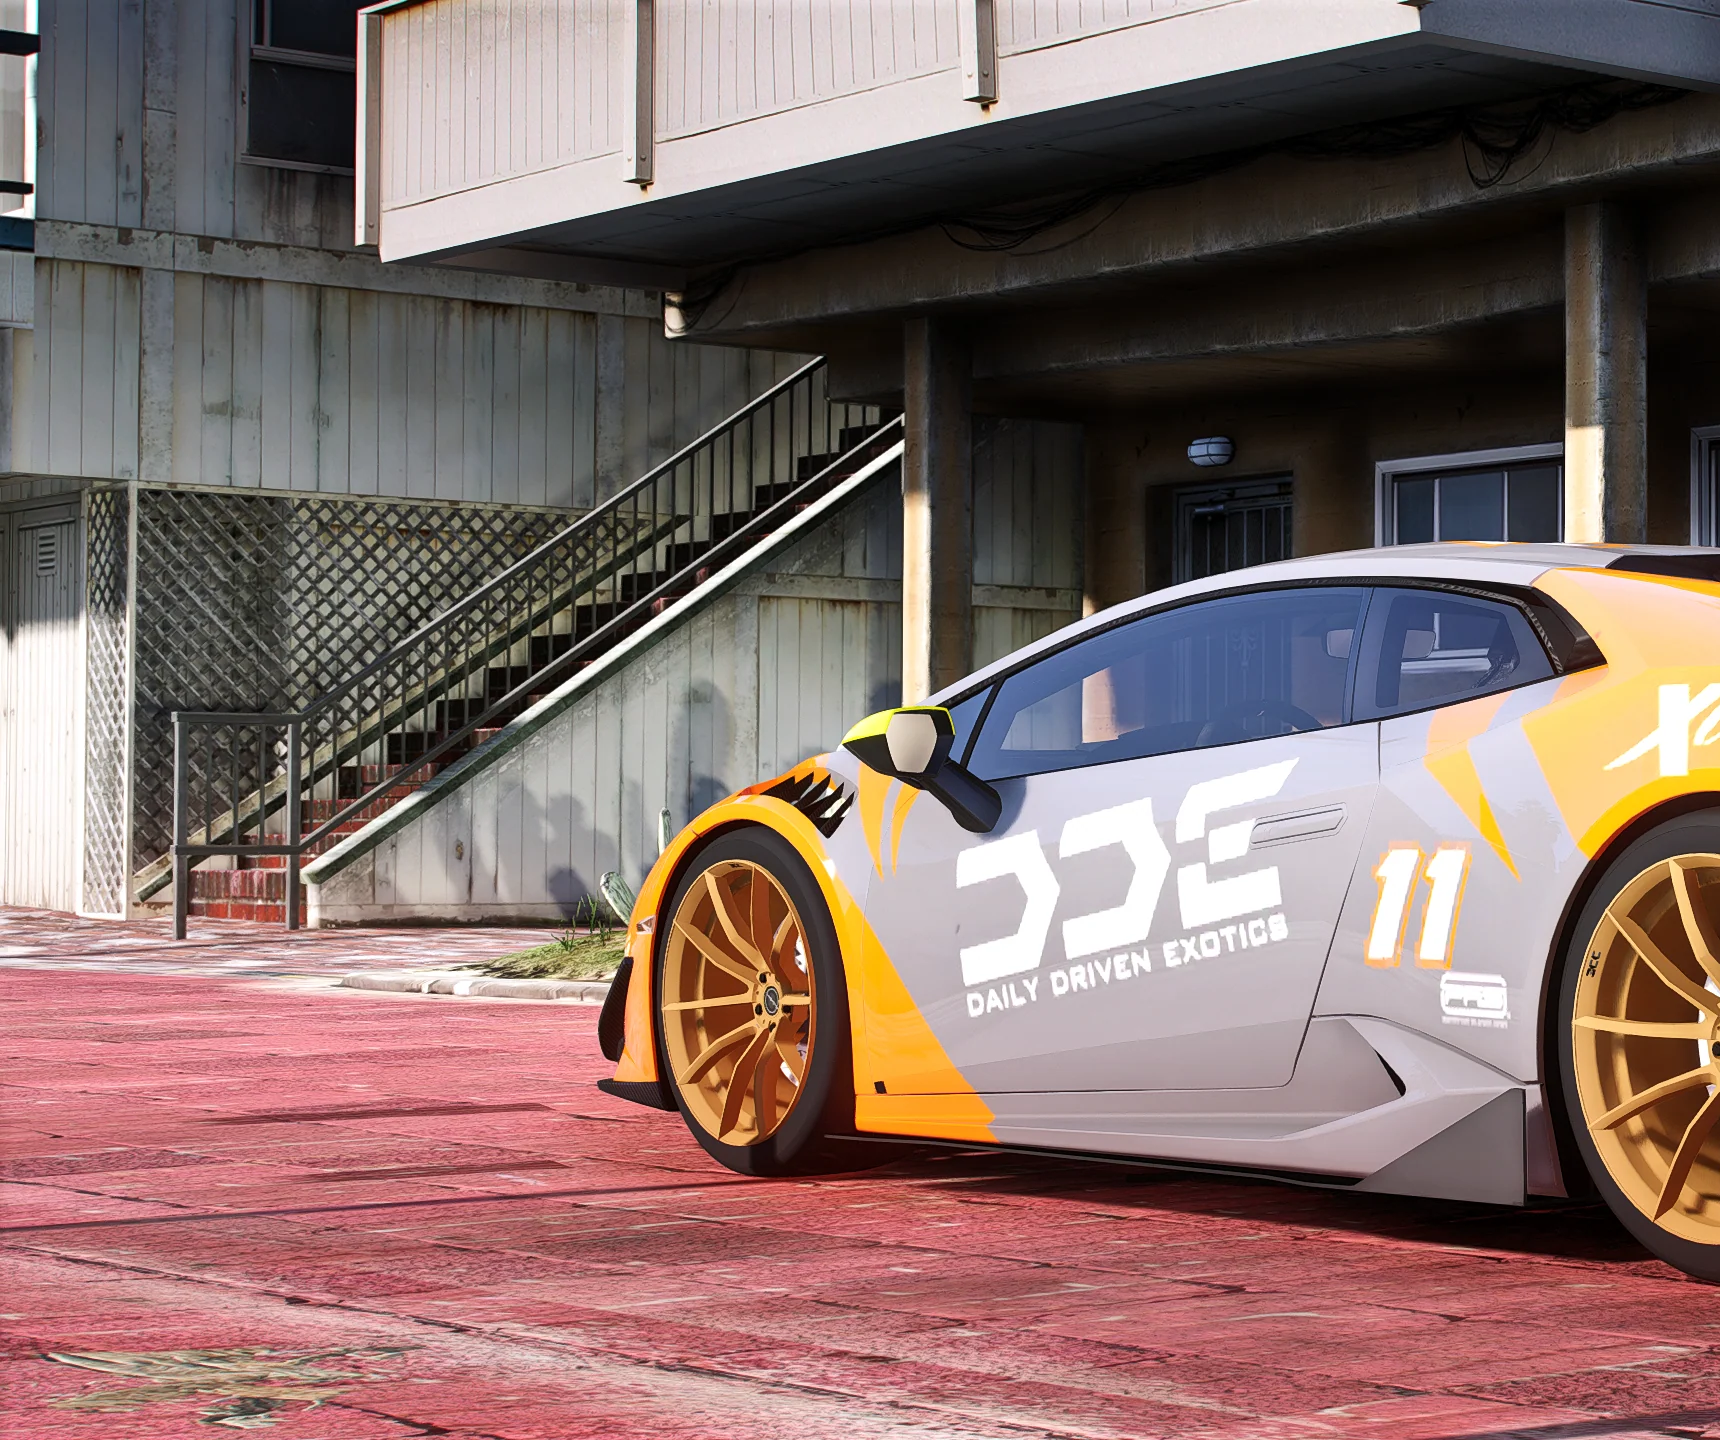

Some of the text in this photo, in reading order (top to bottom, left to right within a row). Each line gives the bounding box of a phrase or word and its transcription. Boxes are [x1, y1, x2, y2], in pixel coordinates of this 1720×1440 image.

[1364, 841, 1473, 970] 11
[966, 912, 1288, 1018] DAILY DRIVEN EXOTICS
